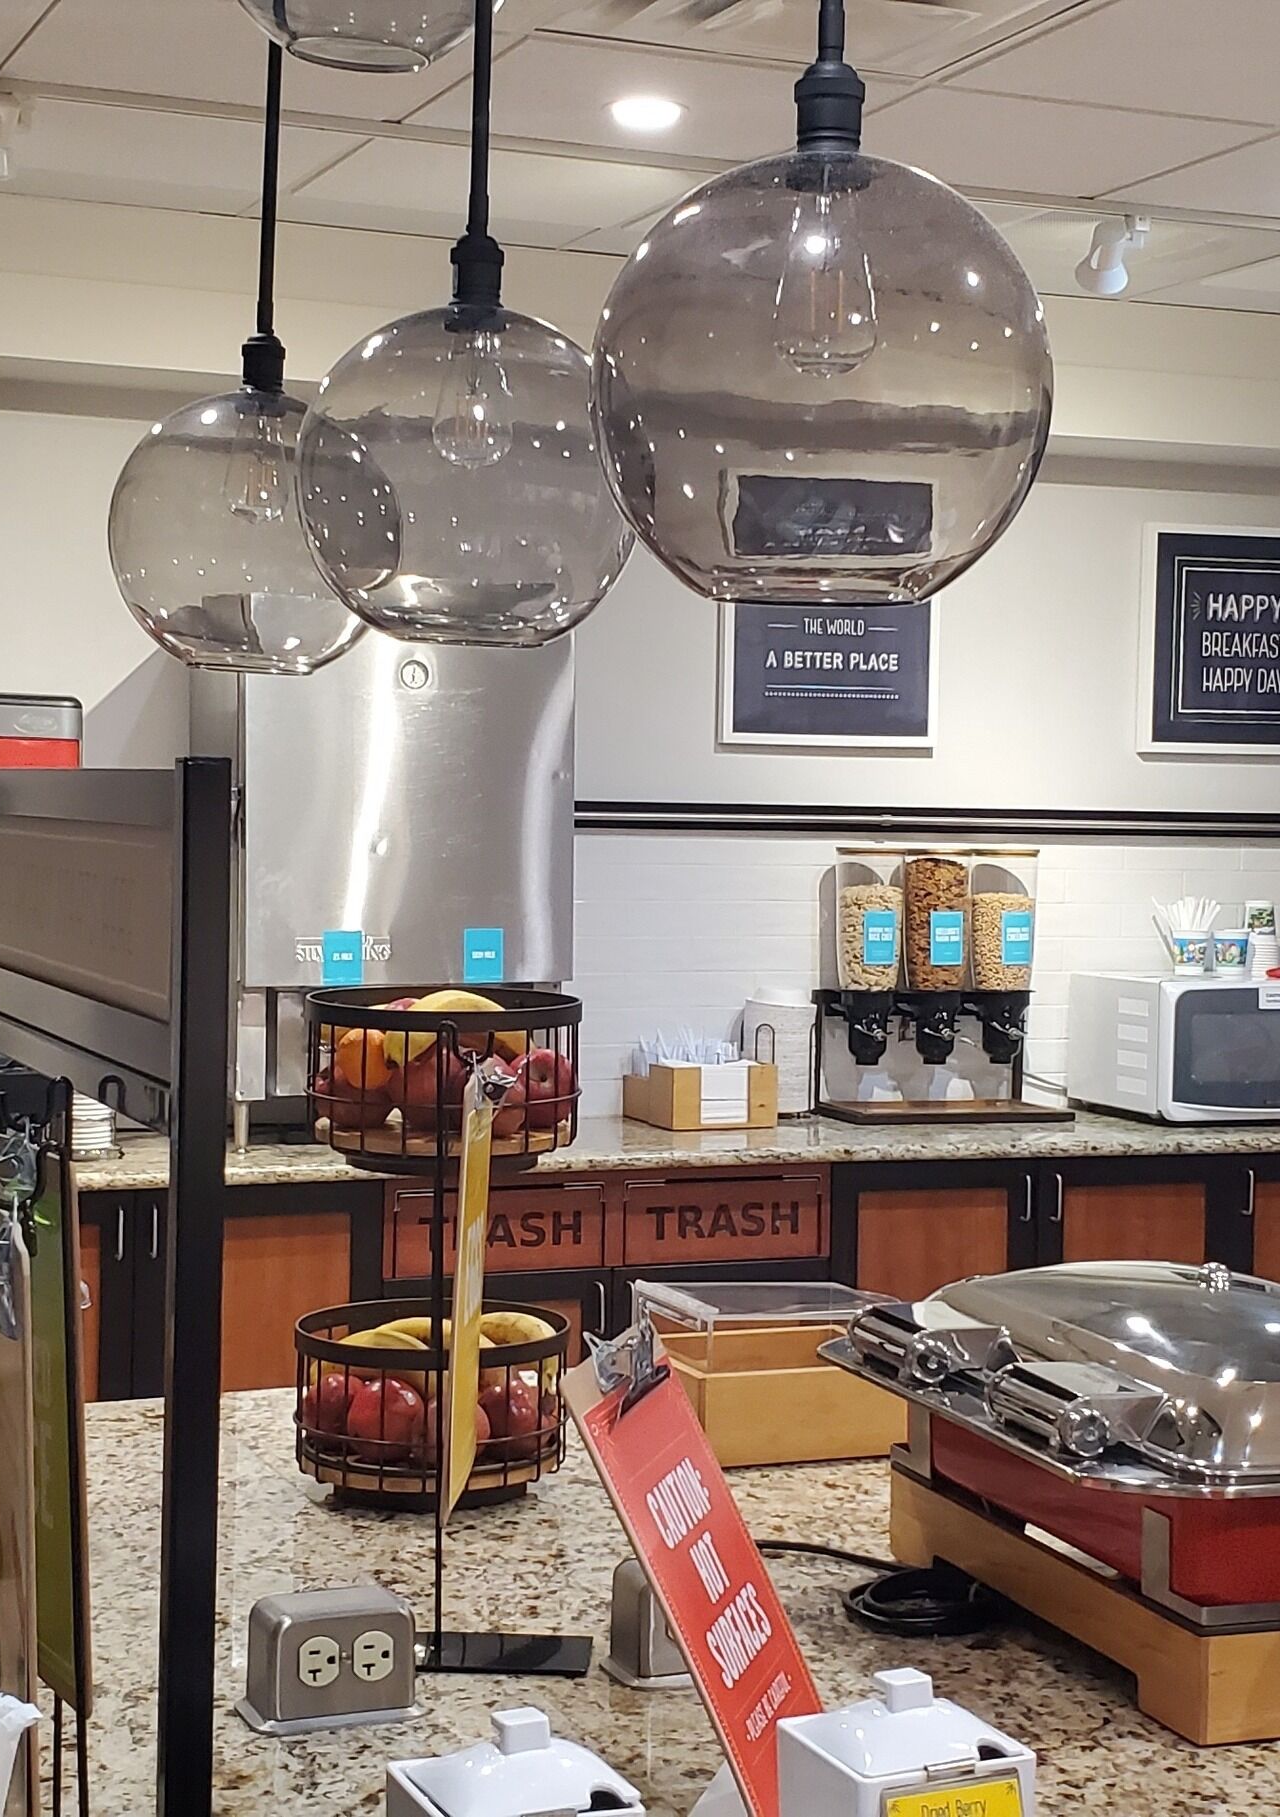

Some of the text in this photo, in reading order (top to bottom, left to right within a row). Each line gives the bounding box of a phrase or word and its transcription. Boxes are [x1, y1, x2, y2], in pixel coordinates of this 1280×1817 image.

[803, 617, 865, 636] THE WORLD
[765, 650, 899, 672] A BETTER PLACE
[1202, 666, 1253, 692] HAPPY
[419, 1209, 583, 1252] TASH
[646, 1201, 801, 1241] TRASH
[645, 1457, 713, 1550] CAUTION:
[689, 1531, 731, 1604] HOT
[705, 1581, 772, 1689] SURFACES
